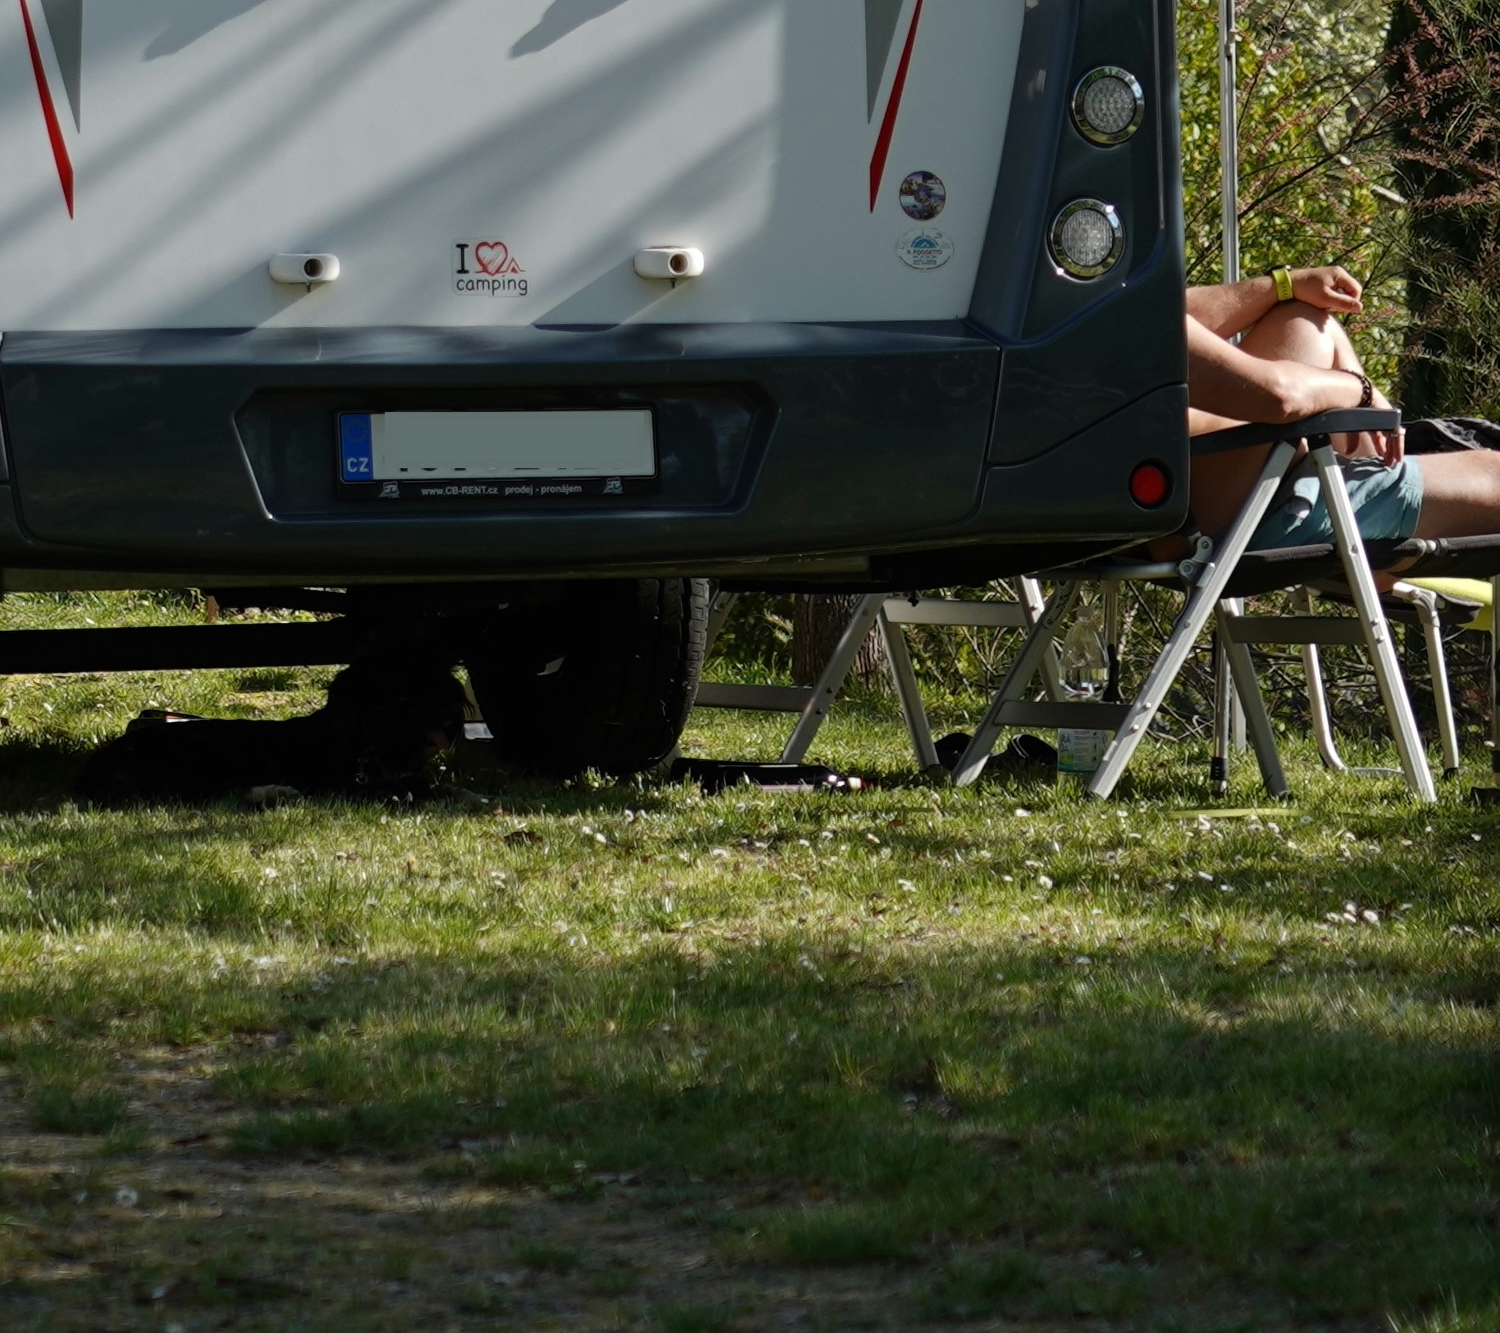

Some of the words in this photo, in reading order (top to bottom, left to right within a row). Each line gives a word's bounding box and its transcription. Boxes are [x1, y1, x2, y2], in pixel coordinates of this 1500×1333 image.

[455, 243, 470, 274] I
[456, 275, 528, 296] camping
[347, 458, 369, 473] CZ
[421, 485, 499, 496] www.CB-RENT.cz
[505, 484, 534, 496] prodej
